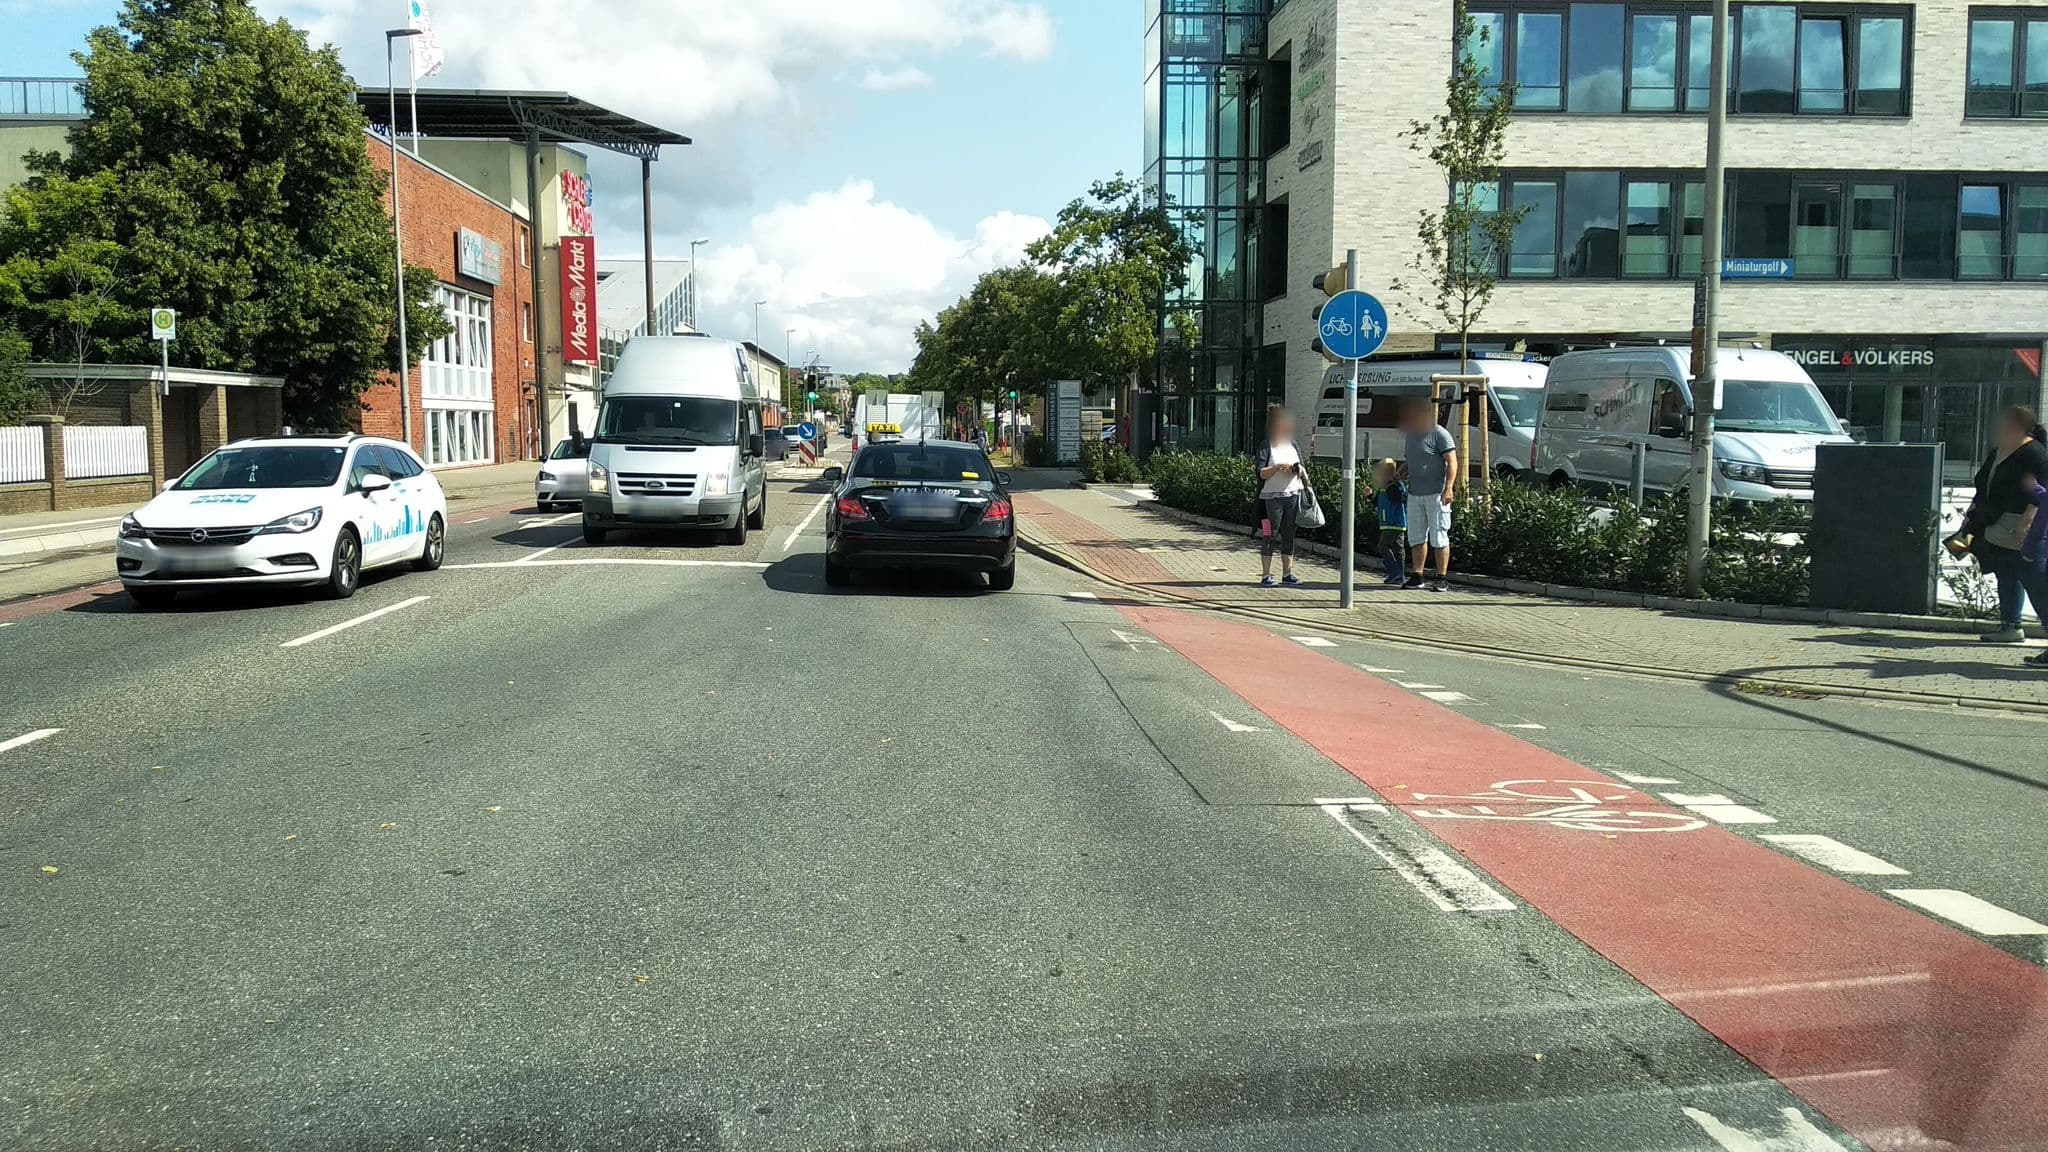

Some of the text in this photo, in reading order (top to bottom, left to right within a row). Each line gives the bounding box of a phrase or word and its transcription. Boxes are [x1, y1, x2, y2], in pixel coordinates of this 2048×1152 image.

[1726, 260, 1779, 274] Miniaturgolf
[568, 240, 588, 356] Media Markt
[871, 423, 896, 432] TAXI
